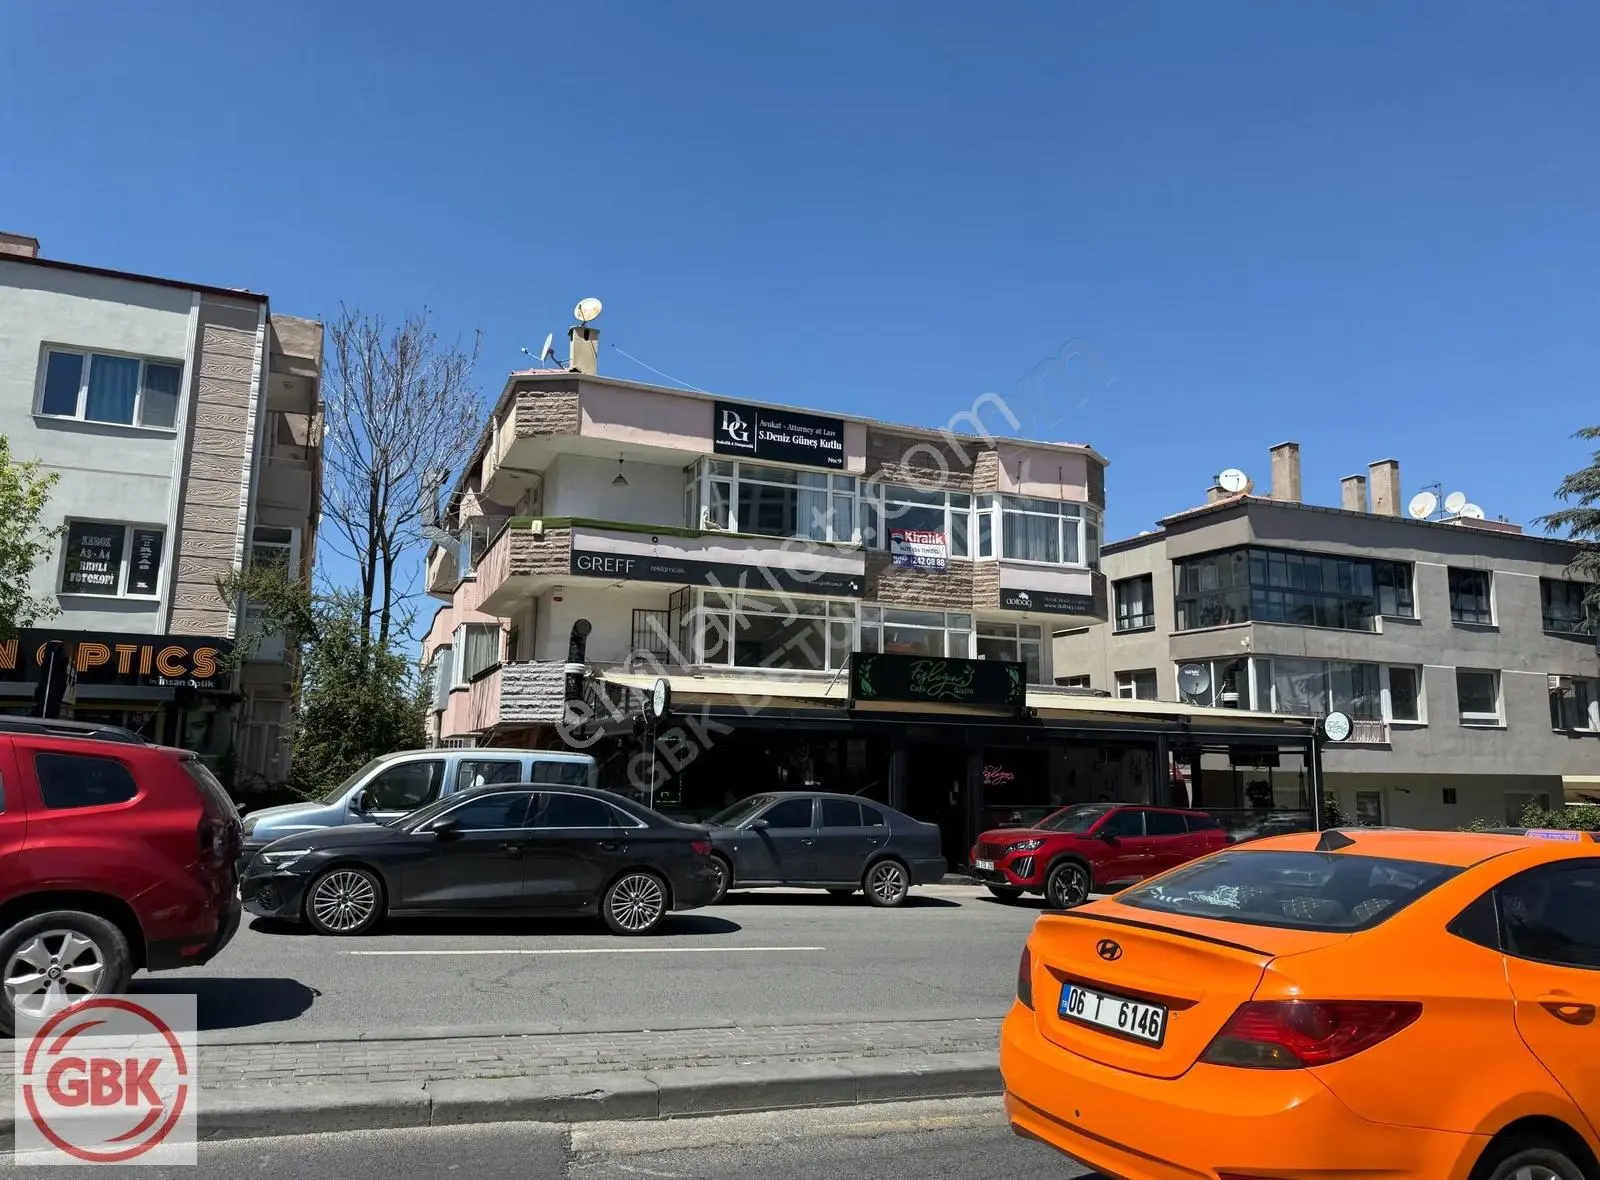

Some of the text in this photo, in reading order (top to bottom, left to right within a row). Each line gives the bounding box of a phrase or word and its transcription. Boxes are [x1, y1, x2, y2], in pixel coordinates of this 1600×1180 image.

[759, 419, 782, 430] Avukat
[787, 424, 814, 436] Attorney
[823, 429, 837, 437] Law
[758, 430, 842, 450] S.Deniz Güneş Kutlu
[904, 531, 945, 545] Kiralık
[577, 555, 636, 574] GREFF
[187, 679, 214, 689] Optik
[1069, 988, 1086, 1015] 06
[1095, 994, 1104, 1020] T
[1118, 1002, 1160, 1037] 6146
